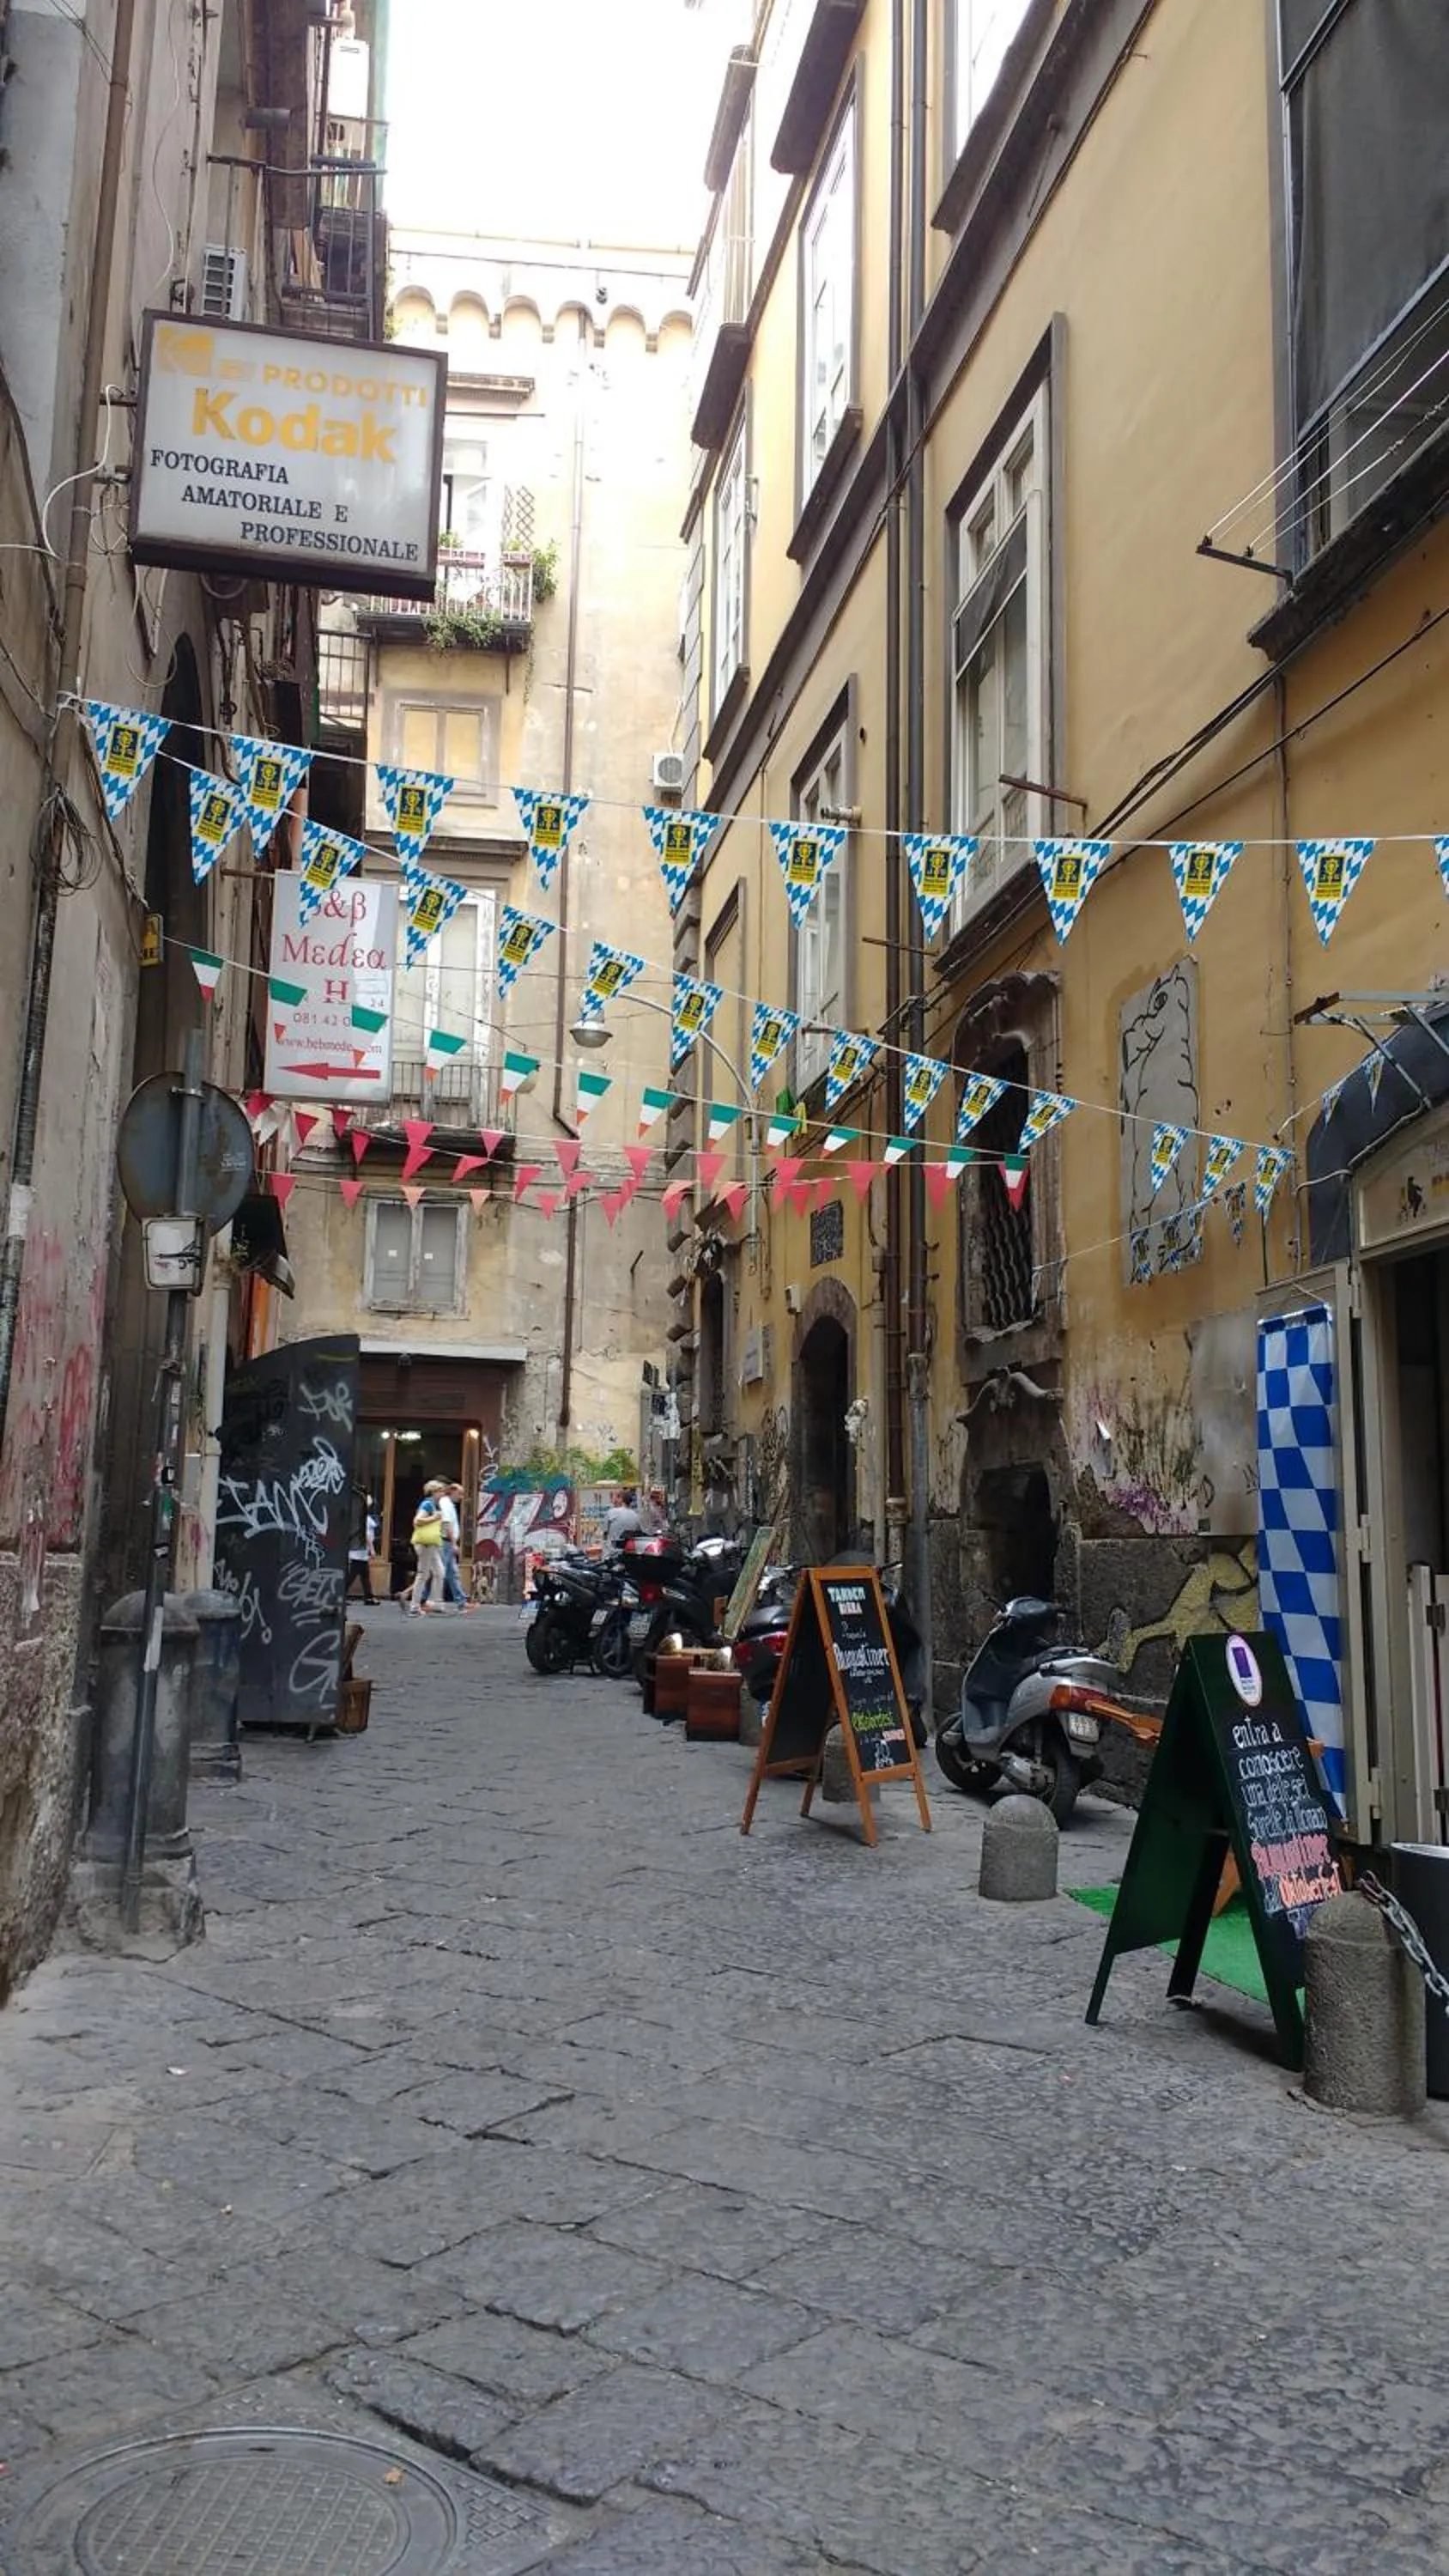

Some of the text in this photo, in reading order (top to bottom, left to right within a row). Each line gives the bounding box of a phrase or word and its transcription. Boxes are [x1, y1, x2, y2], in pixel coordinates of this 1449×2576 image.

[263, 364, 427, 408] PRODOTTI
[191, 387, 397, 465] Kodak
[150, 448, 289, 485] FOTOGRAFIA
[181, 484, 349, 523] AMATORIALE E
[239, 521, 420, 562] PROFESSIONALE
[323, 978, 349, 1005] H
[292, 1012, 318, 1024] 081
[1232, 1715, 1283, 1749] entra a
[1238, 1745, 1305, 1780] conoscere
[1240, 1782, 1267, 1807] una
